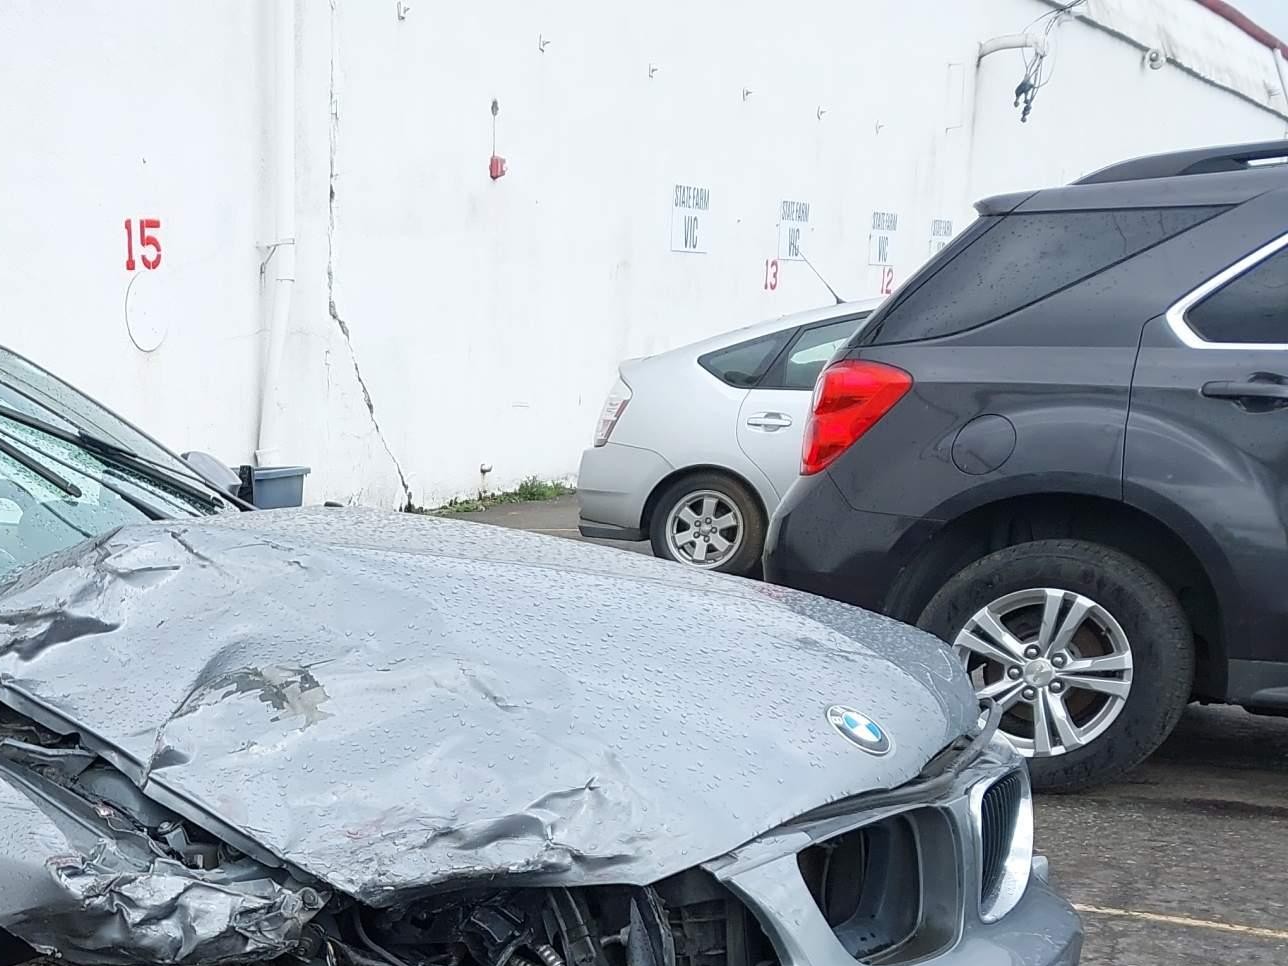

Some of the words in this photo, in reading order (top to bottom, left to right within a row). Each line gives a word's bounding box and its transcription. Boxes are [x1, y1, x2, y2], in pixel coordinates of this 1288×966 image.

[675, 184, 692, 208] STATE
[692, 186, 710, 211] FARM
[124, 218, 162, 271] 15
[684, 216, 698, 248] VIC
[788, 227, 800, 257] VIC
[764, 259, 779, 290] 13
[880, 266, 894, 295] 12
